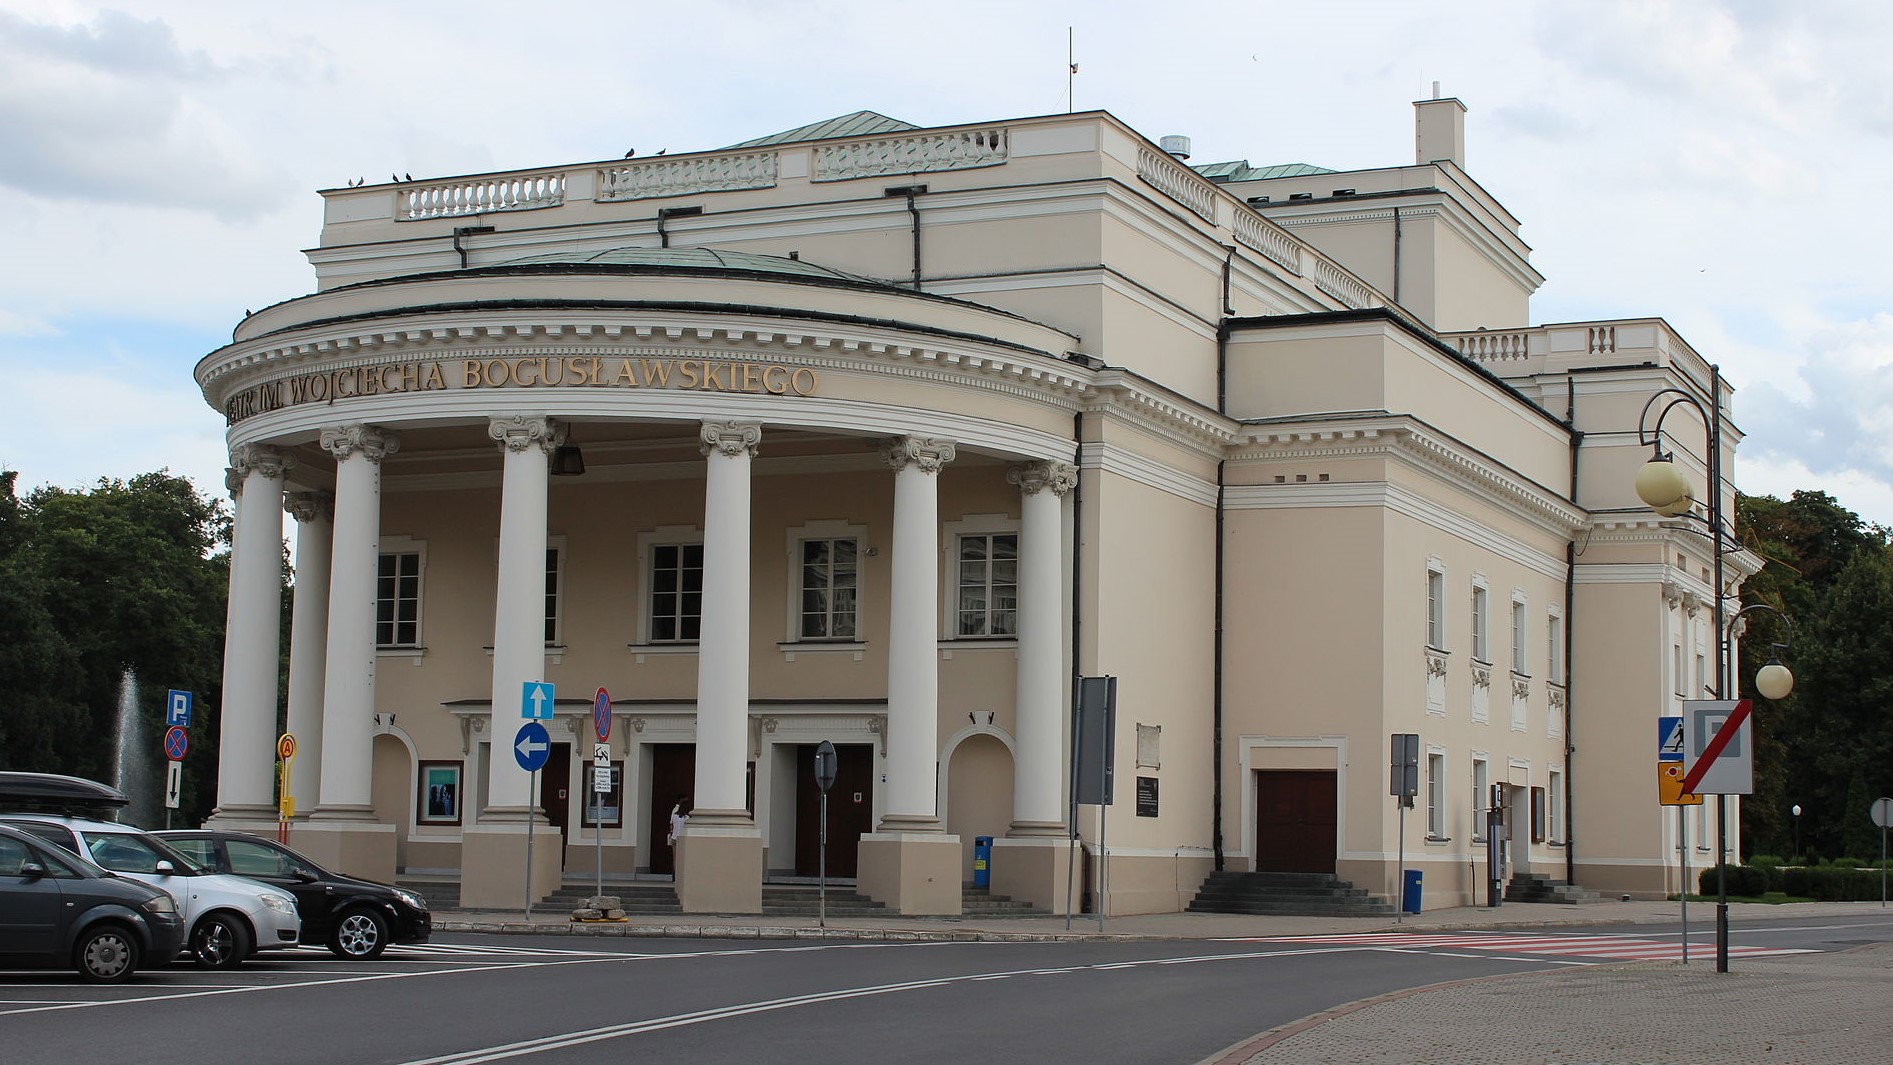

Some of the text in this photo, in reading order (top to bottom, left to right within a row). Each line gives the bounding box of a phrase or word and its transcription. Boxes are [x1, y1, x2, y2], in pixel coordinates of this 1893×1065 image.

[290, 361, 447, 405] WOJCIECHA
[461, 357, 819, 396] BOGUSŁAWSKIEGO
[172, 694, 187, 722] P
[284, 741, 291, 754] A
